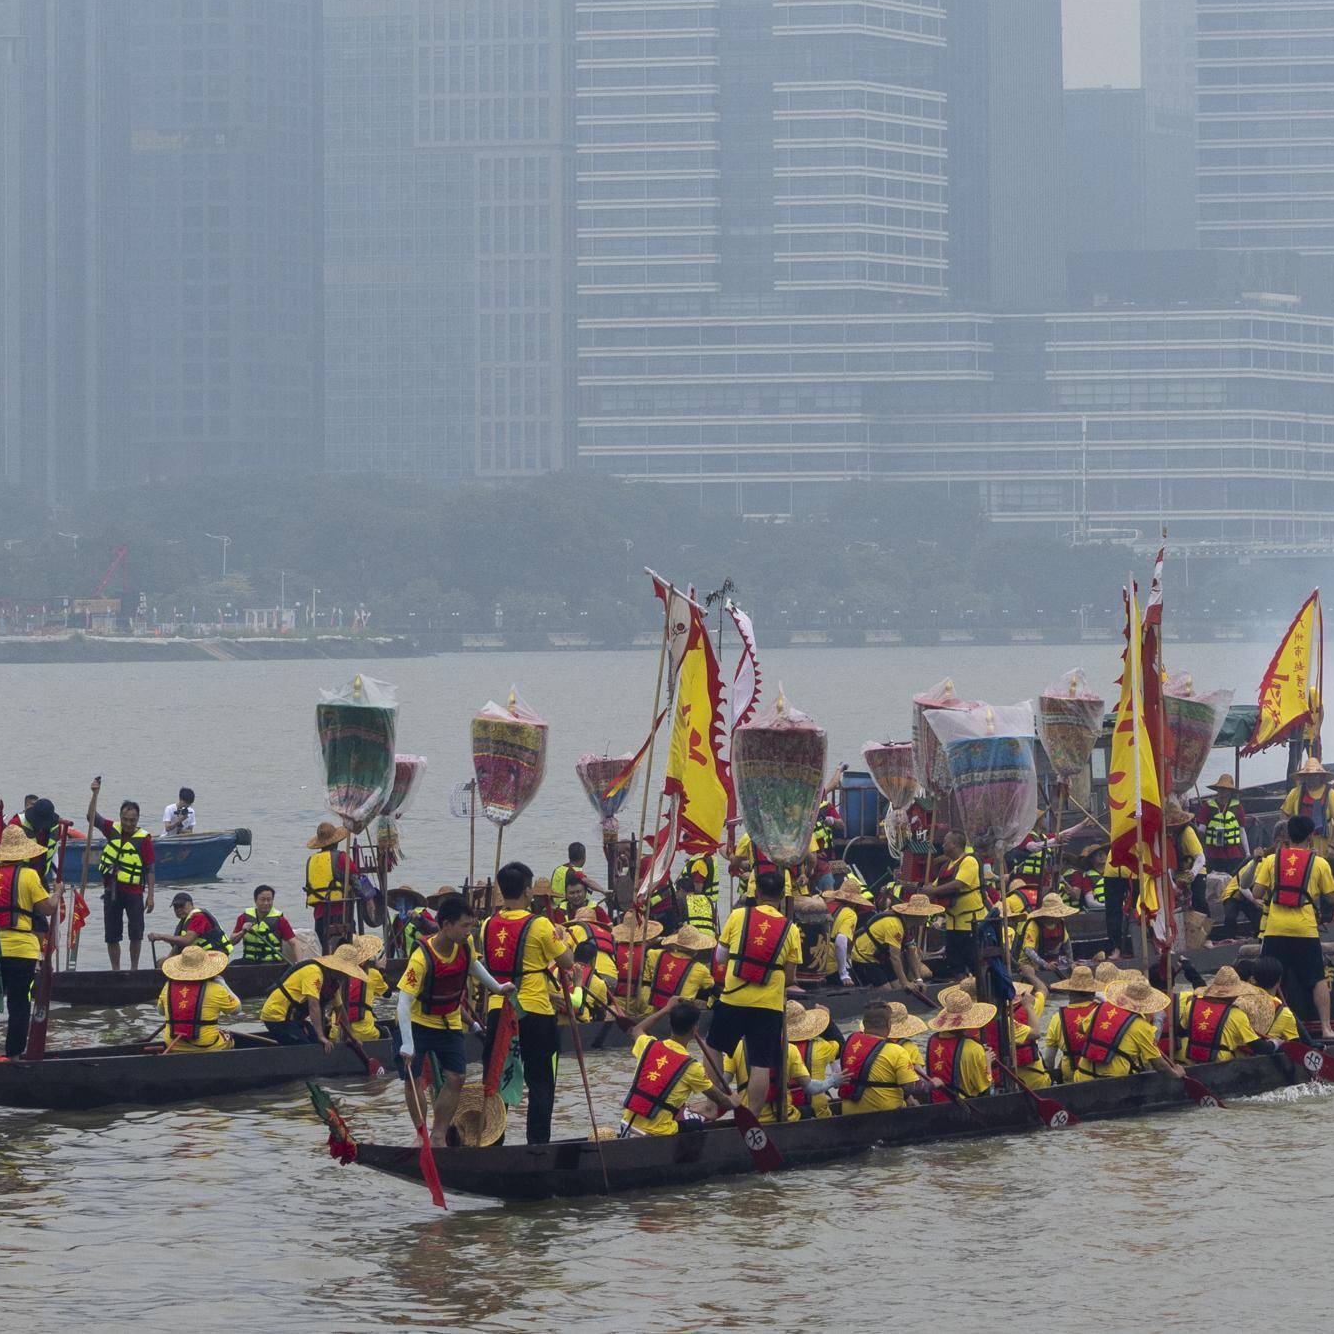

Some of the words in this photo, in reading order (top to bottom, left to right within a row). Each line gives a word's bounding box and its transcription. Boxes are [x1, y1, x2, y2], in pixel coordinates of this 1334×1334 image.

[1285, 853, 1299, 876] 寺右
[494, 928, 509, 957] 寺右
[754, 920, 771, 946] 寺右
[662, 961, 676, 982] 寺右
[179, 986, 190, 1010] 寺右
[1100, 1008, 1117, 1030] 寺右
[1198, 1007, 1213, 1031] 寺右
[847, 1039, 862, 1065] 寺右
[934, 1043, 945, 1071] 寺右
[647, 1055, 668, 1082] 寺右
[747, 1129, 763, 1148] 右
